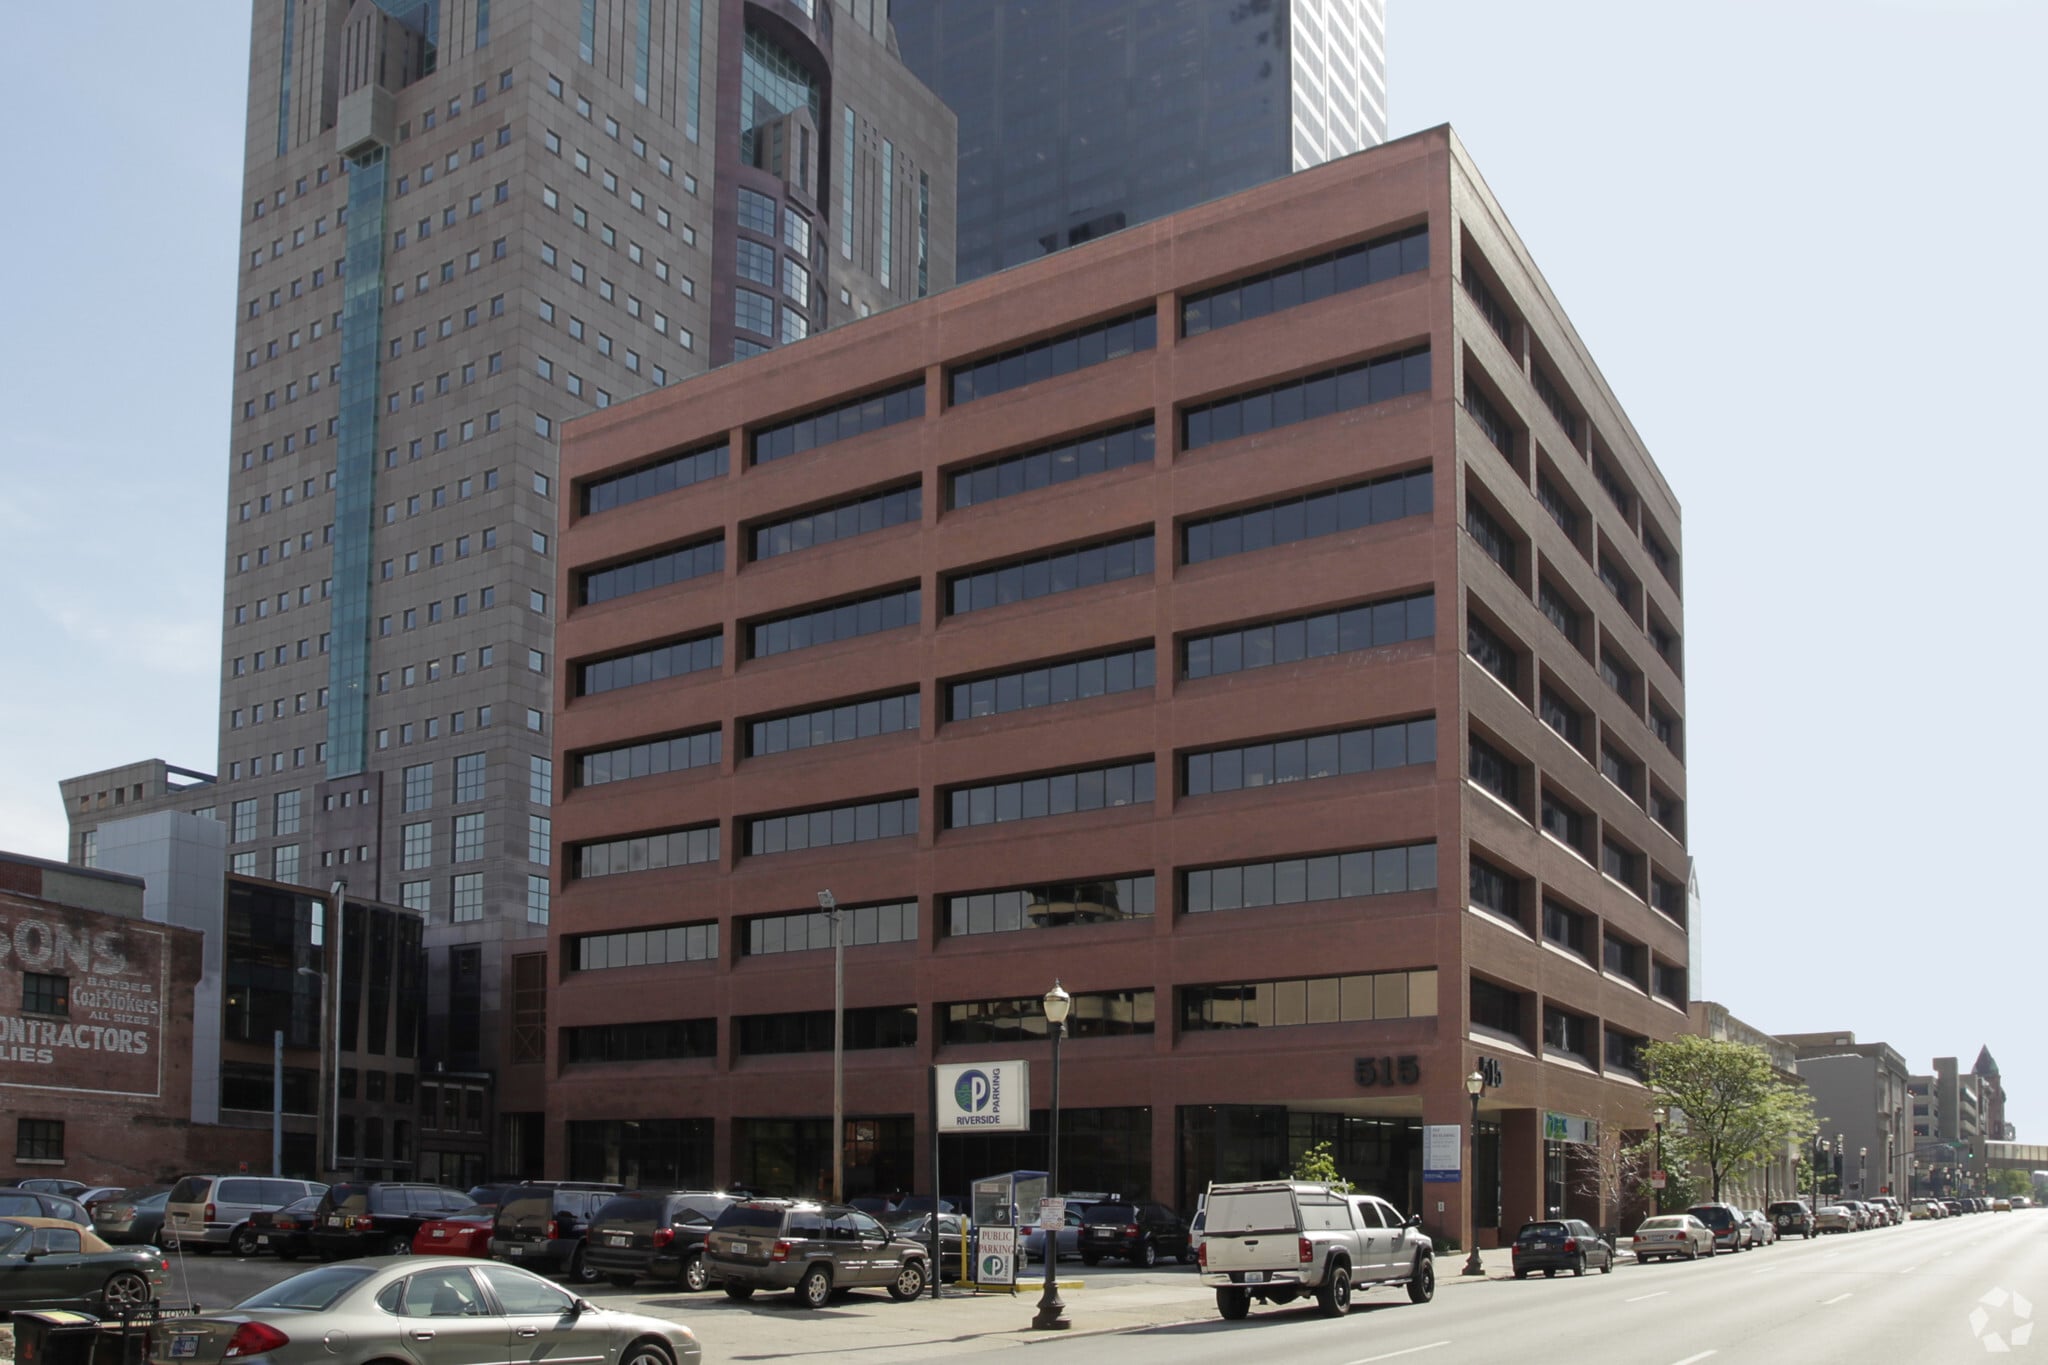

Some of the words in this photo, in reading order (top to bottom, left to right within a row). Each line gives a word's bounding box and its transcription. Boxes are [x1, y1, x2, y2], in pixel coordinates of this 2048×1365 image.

[102, 989, 159, 1014] Stokers
[88, 1010, 110, 1021] ALL
[113, 1013, 150, 1025] SIZES
[0, 1045, 54, 1064] LIES
[1354, 1054, 1421, 1087] 515
[992, 1067, 1000, 1113] PARKING
[956, 1115, 1001, 1126] RIVERSIDE
[982, 1231, 1012, 1241] PUBLIC
[978, 1244, 1014, 1255] PARKING
